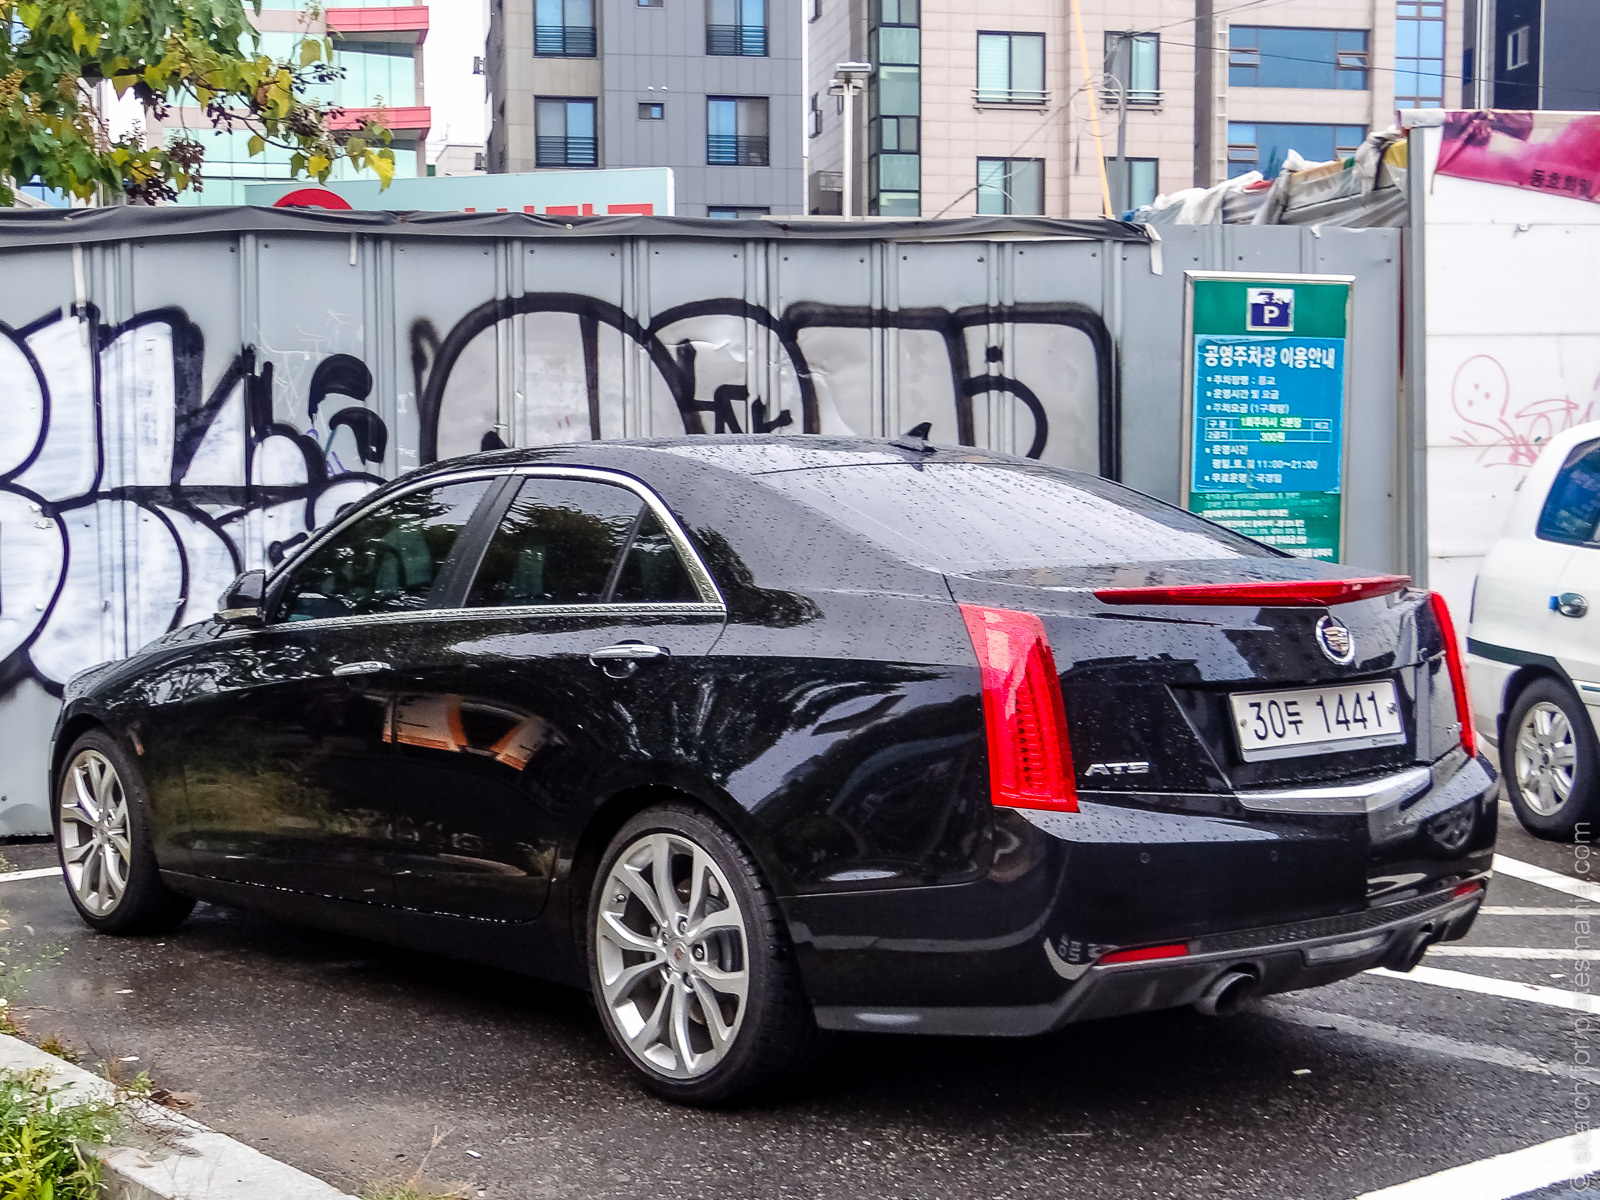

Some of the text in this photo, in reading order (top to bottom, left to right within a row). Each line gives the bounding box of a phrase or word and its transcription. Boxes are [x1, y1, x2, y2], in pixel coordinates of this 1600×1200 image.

[1263, 305, 1280, 324] P
[1204, 345, 1336, 369] 공영주차장 이용안내
[1212, 375, 1249, 386] 주차장명
[1212, 388, 1249, 400] 운영시간
[1260, 389, 1280, 400] 요금
[1211, 403, 1249, 414] 주차요금
[1241, 416, 1278, 428] 1회주차시
[1279, 417, 1302, 428] 5분당
[1207, 430, 1286, 443] 2급지 300원
[1211, 444, 1249, 456] 운영시간
[1256, 459, 1319, 470] 11:00~21:00
[1211, 472, 1248, 484] 무료운영
[1248, 690, 1382, 741] 30두 1441
[1084, 761, 1150, 777] ATS
